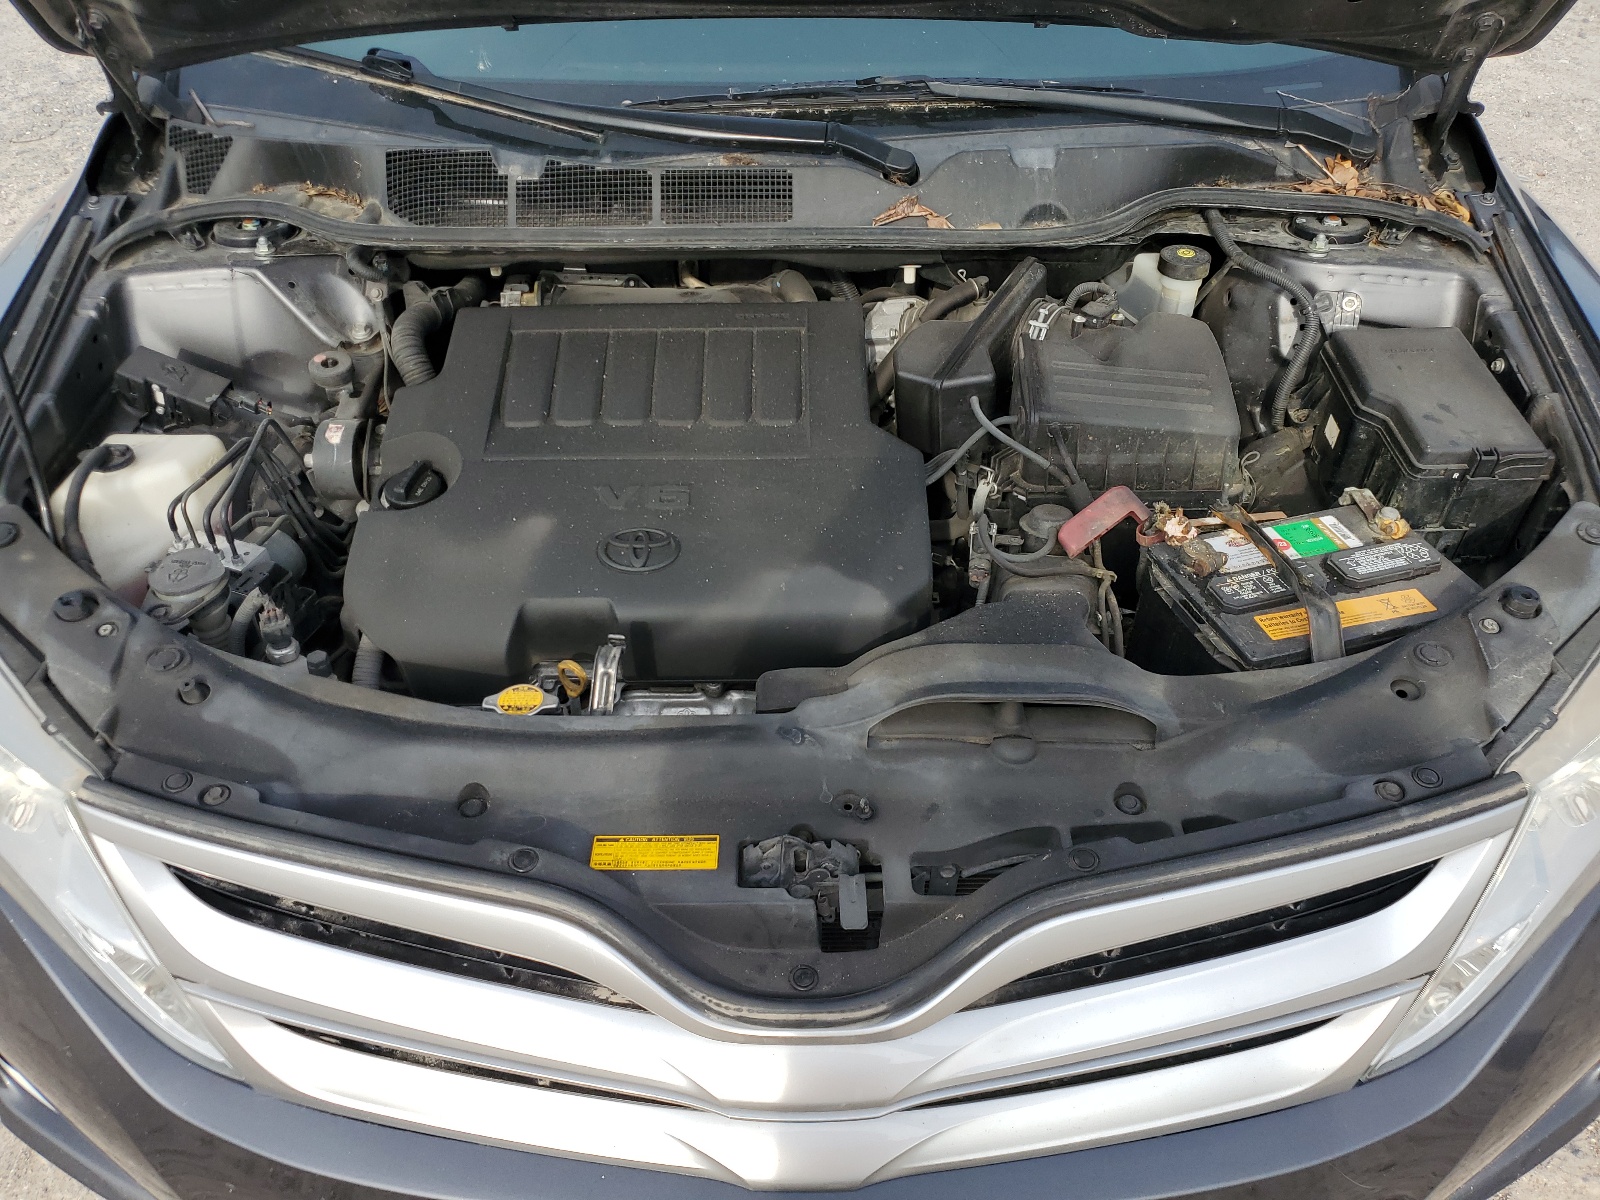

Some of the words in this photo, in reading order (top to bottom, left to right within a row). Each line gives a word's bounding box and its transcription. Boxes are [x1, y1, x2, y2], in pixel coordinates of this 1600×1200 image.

[593, 484, 692, 511] V6
[1231, 571, 1262, 581] DANGER
[1278, 611, 1303, 620] warranty
[1263, 620, 1290, 629] batteries
